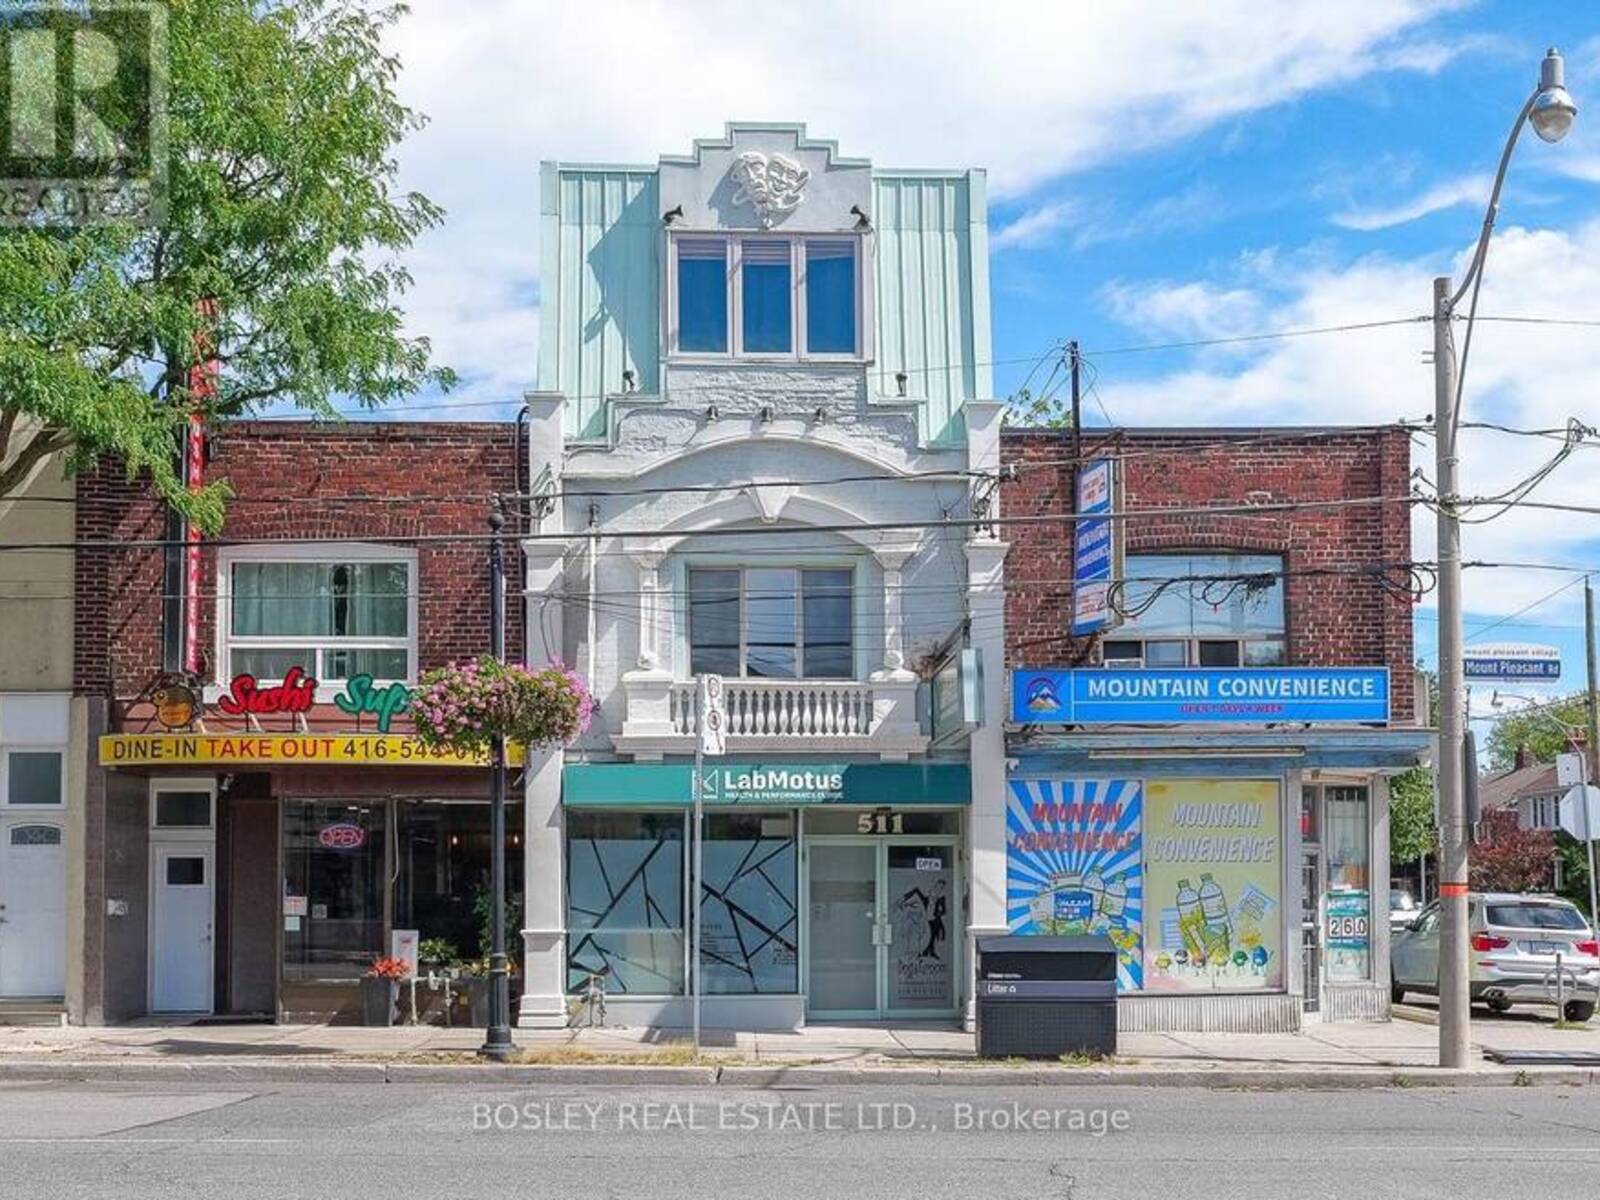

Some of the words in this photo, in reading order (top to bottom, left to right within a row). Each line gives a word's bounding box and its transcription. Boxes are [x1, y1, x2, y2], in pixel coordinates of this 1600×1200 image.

[1466, 661, 1498, 674] Mount
[1500, 661, 1543, 675] Pleasant
[218, 666, 318, 715] Sushi
[1088, 679, 1208, 697] MOUNTAIN
[1218, 678, 1374, 697] CONVENIENCE
[335, 673, 413, 733] Sup
[113, 740, 197, 759] DINE-IN
[206, 739, 272, 758] TAKE
[281, 739, 335, 758] OUT
[724, 770, 843, 790] LabMotus
[857, 813, 904, 833] 511
[1031, 803, 1122, 823] MOUNTAIN
[1173, 802, 1264, 828] MOUNTAIN
[321, 826, 362, 846] OPEN
[1013, 831, 1137, 853] CONVENIENCE
[1153, 836, 1277, 863] CONVENIENCE
[918, 859, 940, 869] OPEN
